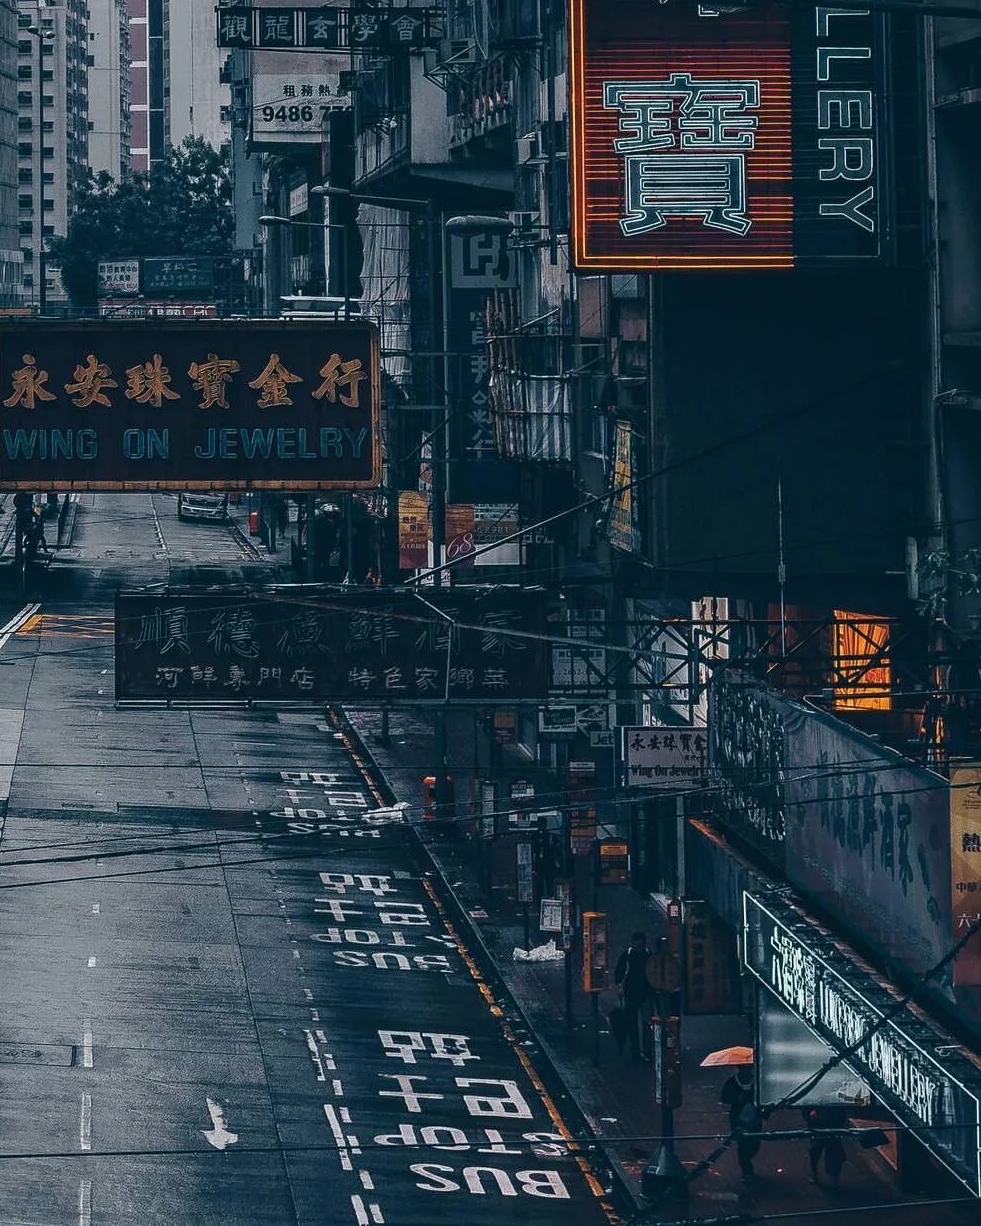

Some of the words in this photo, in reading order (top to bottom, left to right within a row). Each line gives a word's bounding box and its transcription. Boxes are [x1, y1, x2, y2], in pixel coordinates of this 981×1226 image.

[262, 105, 314, 123] 9486
[3, 353, 368, 410] 永安珠寶金行
[3, 427, 99, 461] WING
[122, 427, 170, 461] ON
[194, 427, 368, 461] JEWELRY
[377, 1073, 534, 1119] 巴士
[373, 1123, 581, 1158] STOP
[409, 1163, 571, 1199] BUS
